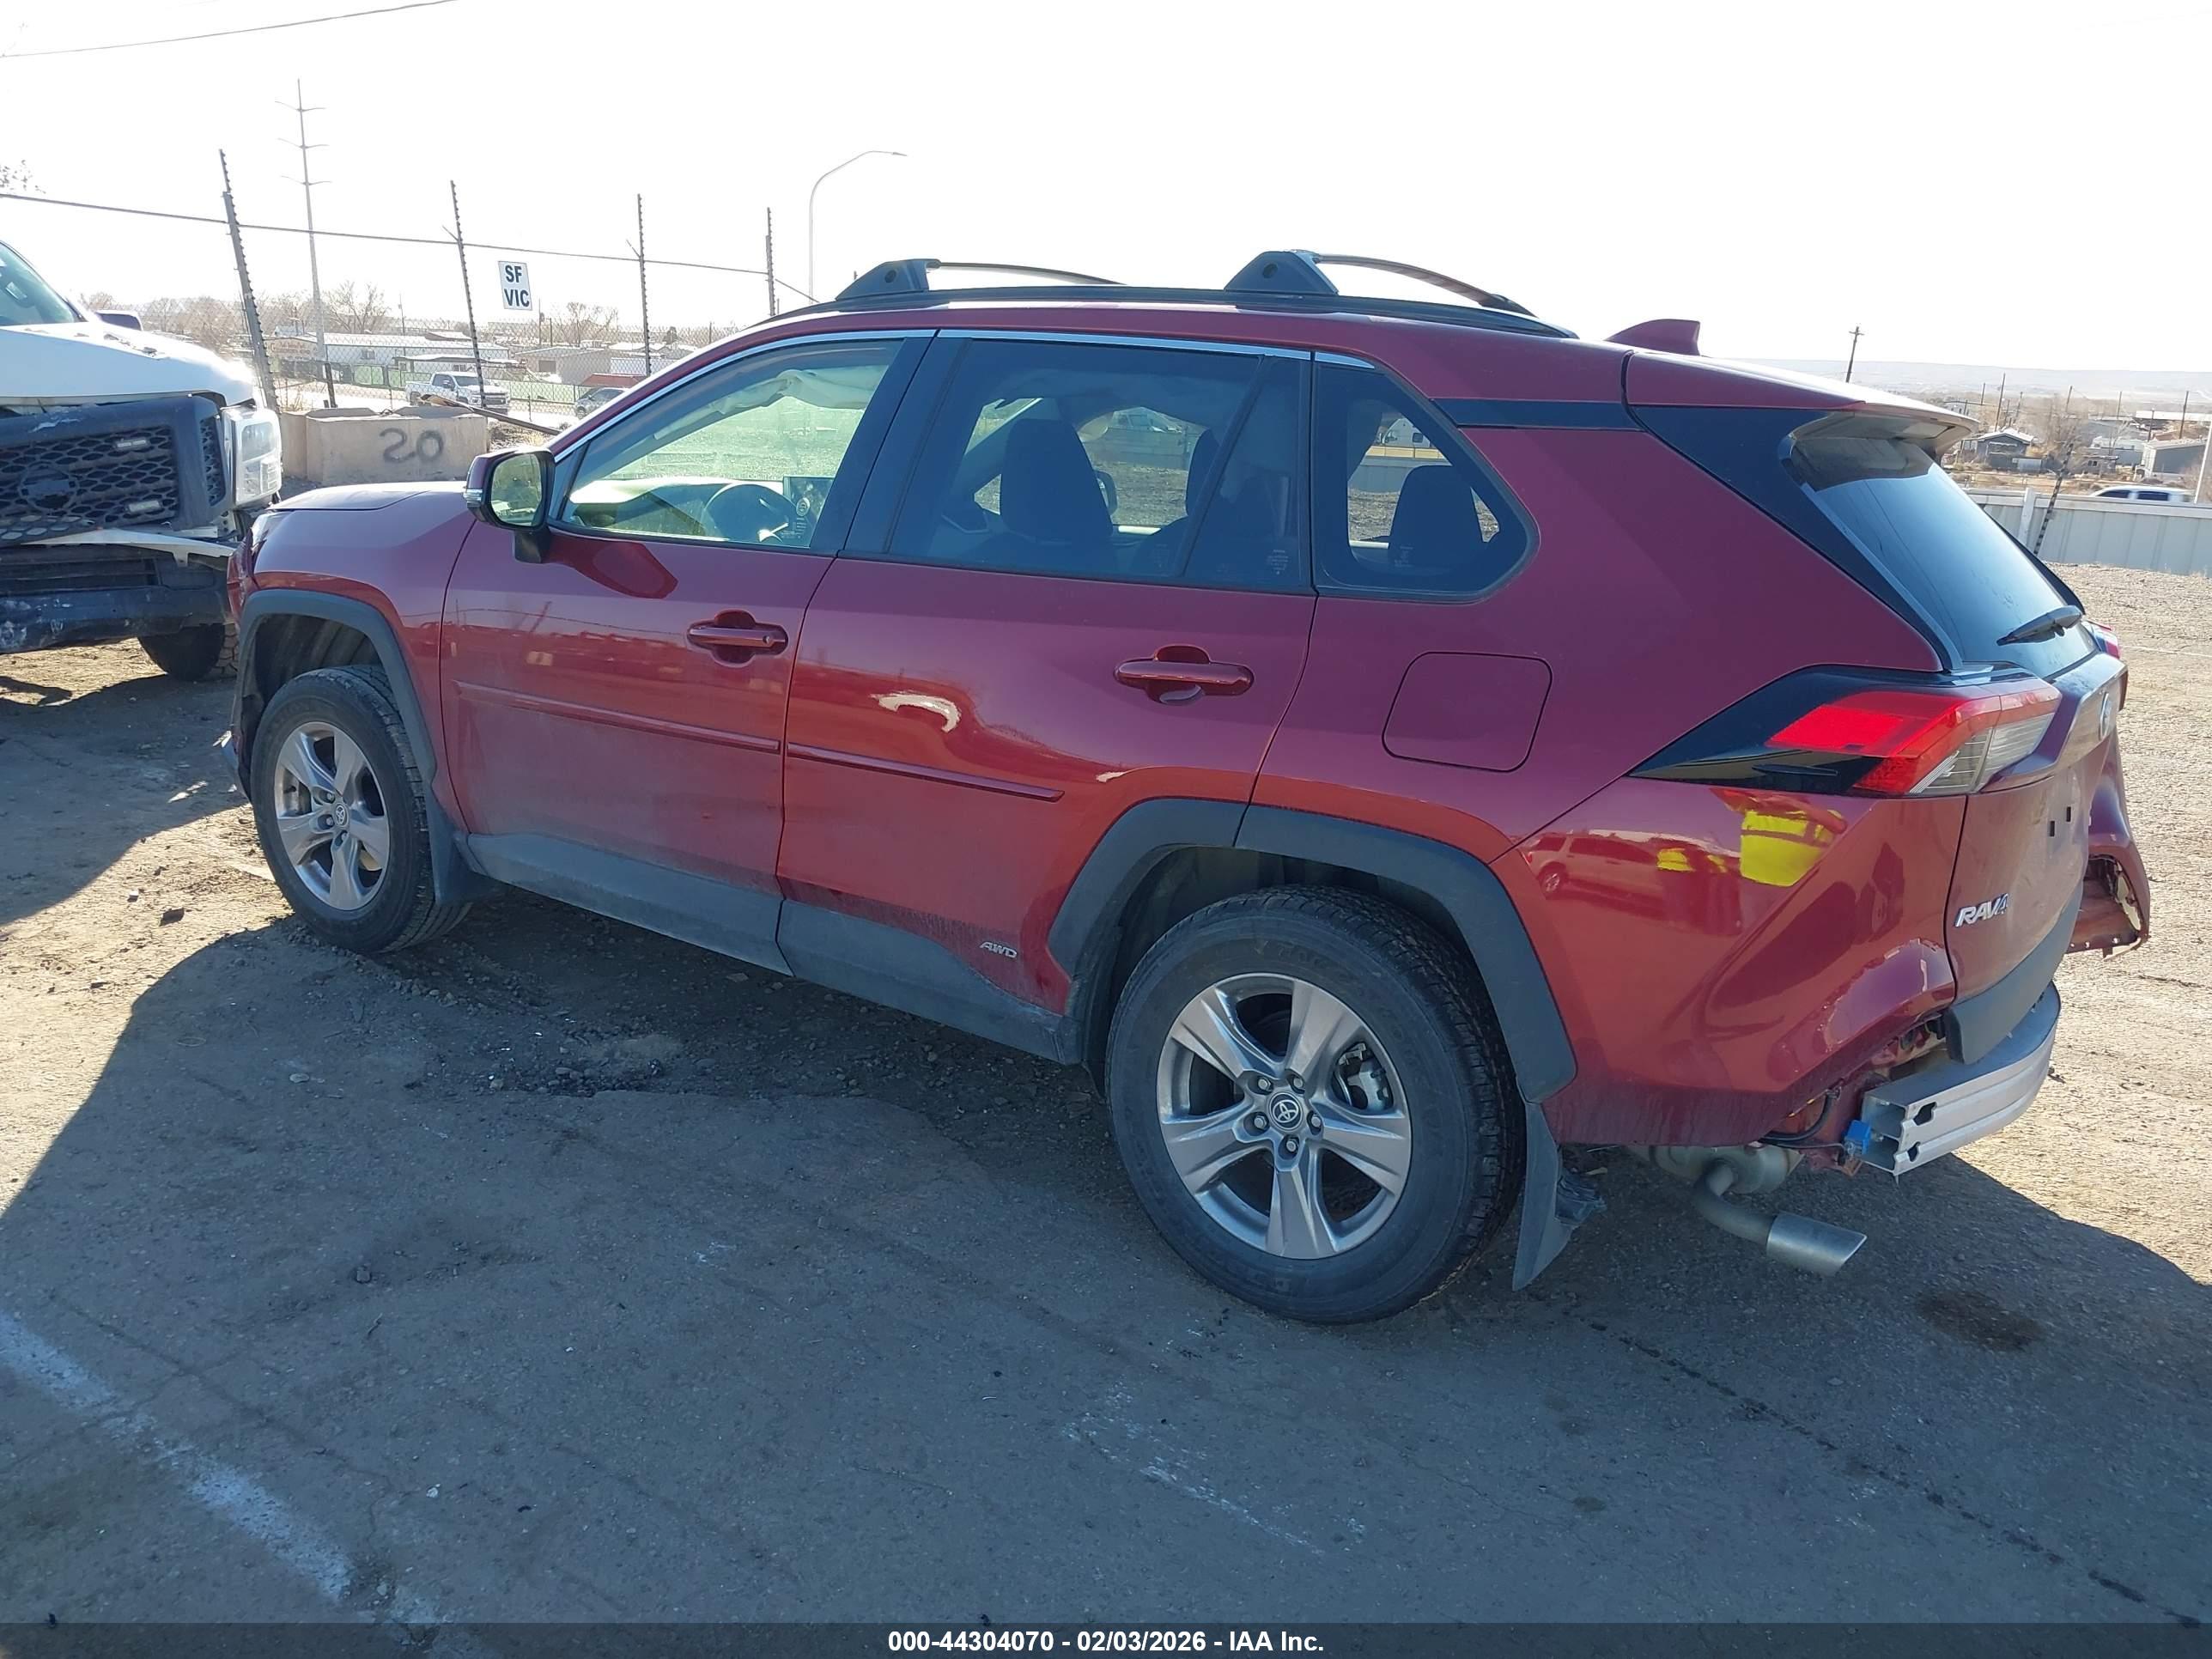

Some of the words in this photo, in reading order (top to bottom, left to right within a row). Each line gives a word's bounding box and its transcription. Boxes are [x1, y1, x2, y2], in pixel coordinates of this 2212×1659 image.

[505, 264, 522, 283] SF
[503, 289, 530, 307] VIC
[379, 428, 444, 464] 20
[1954, 893, 2008, 927] RAV4
[980, 941, 1018, 958] AWD
